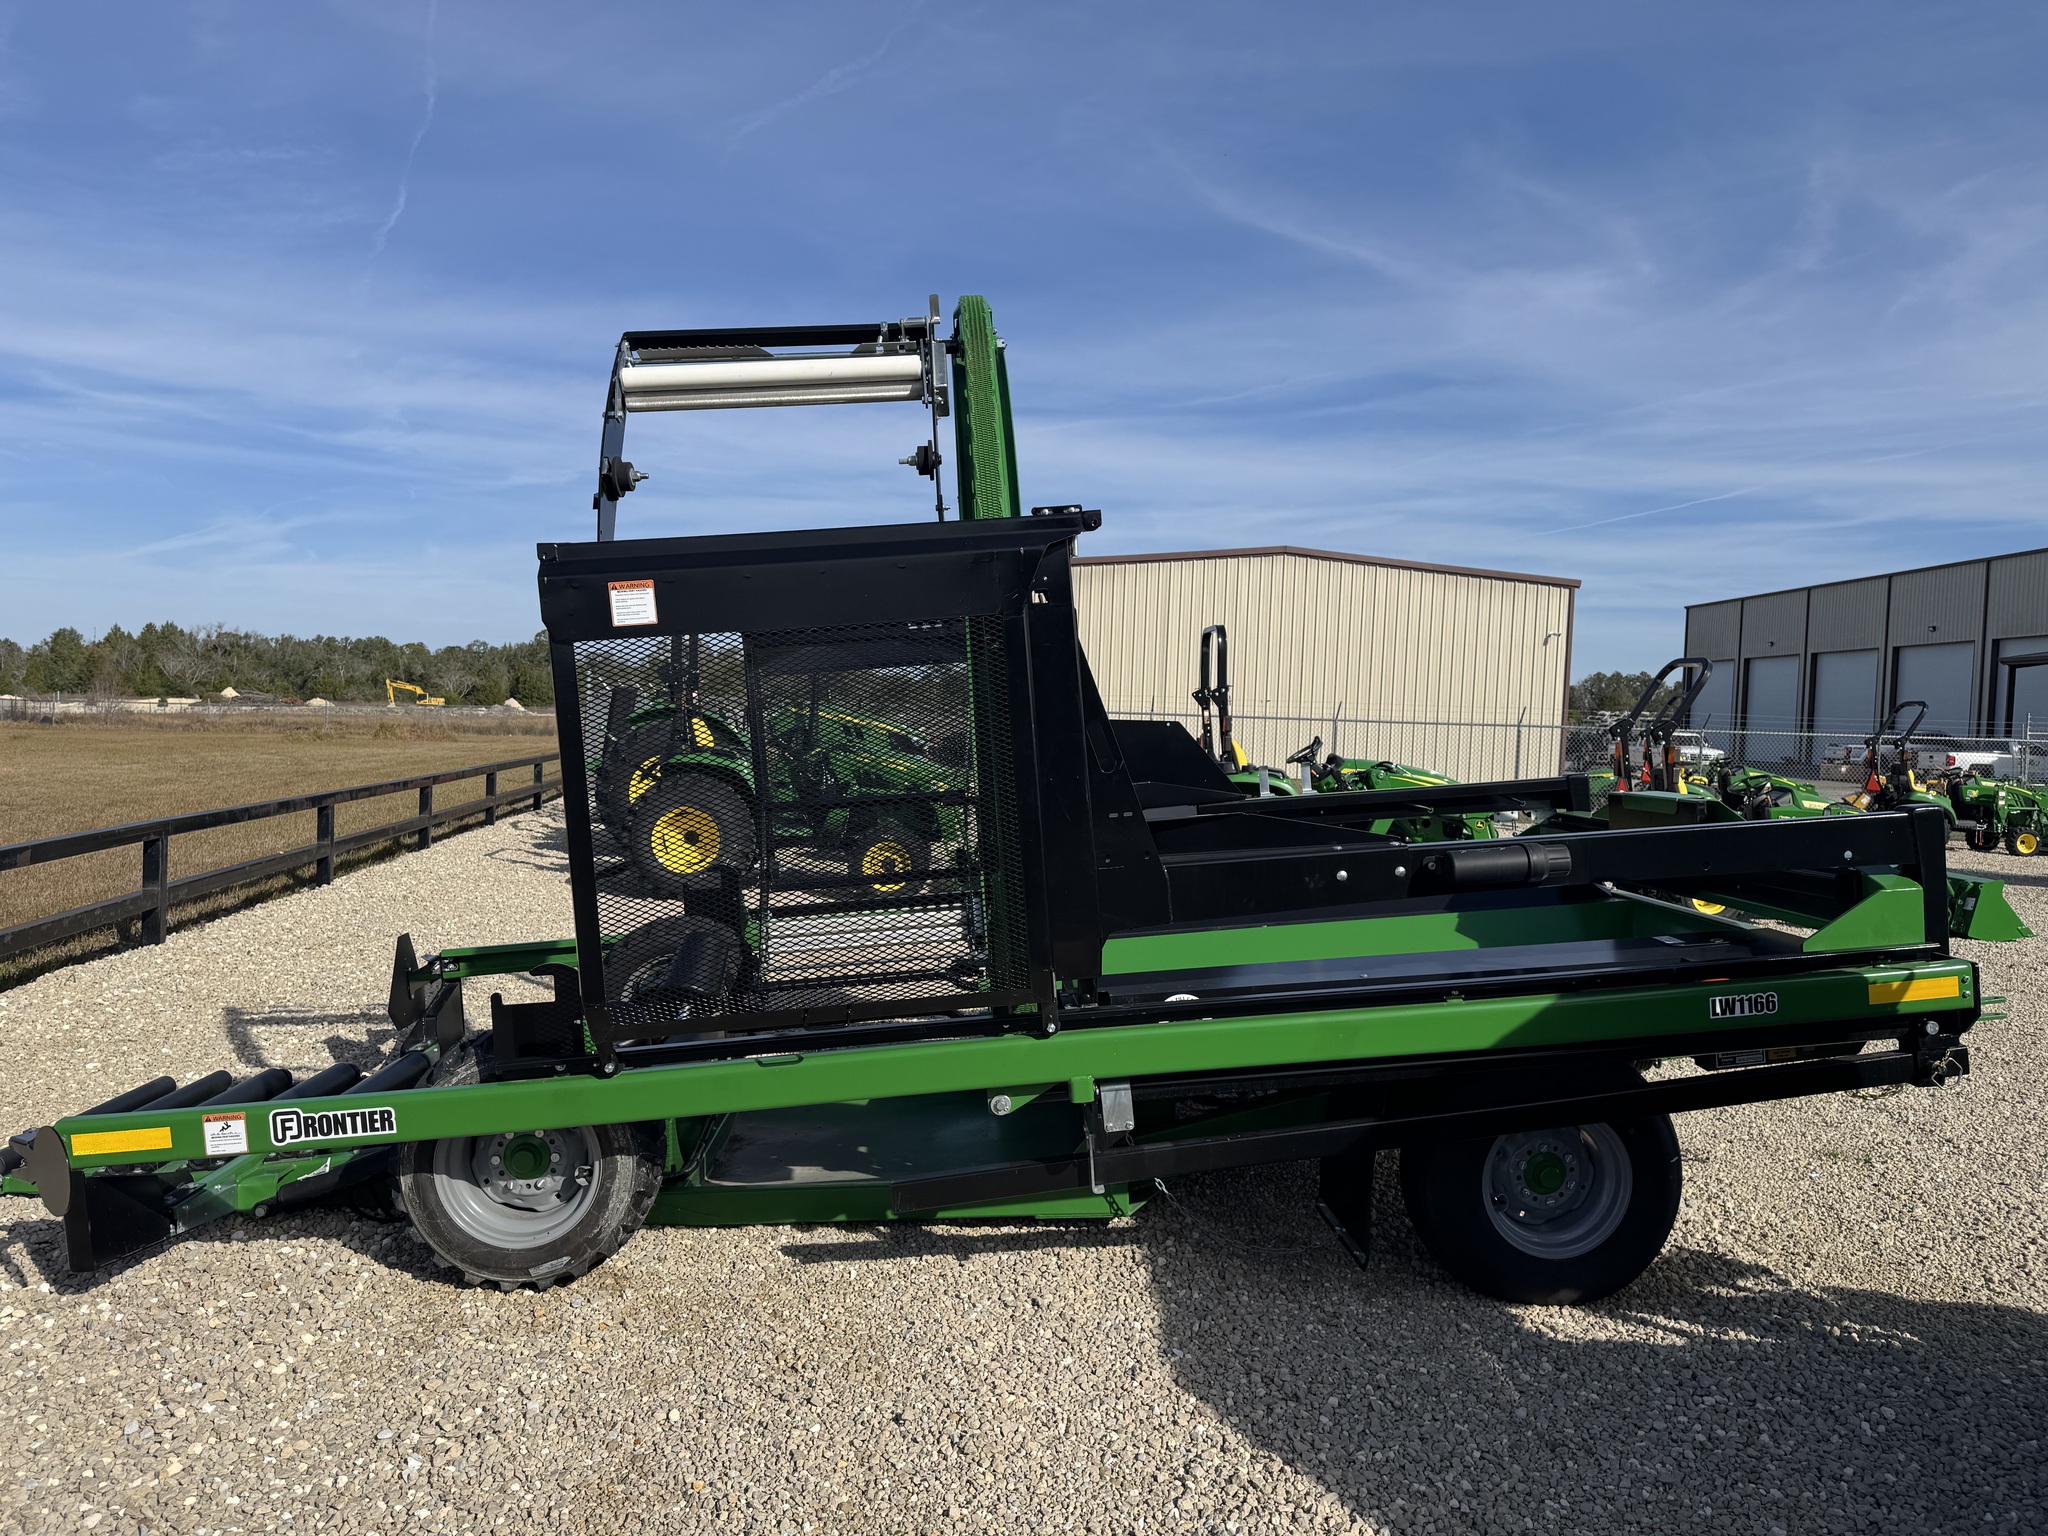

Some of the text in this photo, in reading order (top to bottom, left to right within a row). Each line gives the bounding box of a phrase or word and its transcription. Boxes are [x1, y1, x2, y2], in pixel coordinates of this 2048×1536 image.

[1711, 993, 1777, 1017] LW1166
[212, 1114, 242, 1122] WARNING
[271, 1109, 395, 1144] FRONTIER
